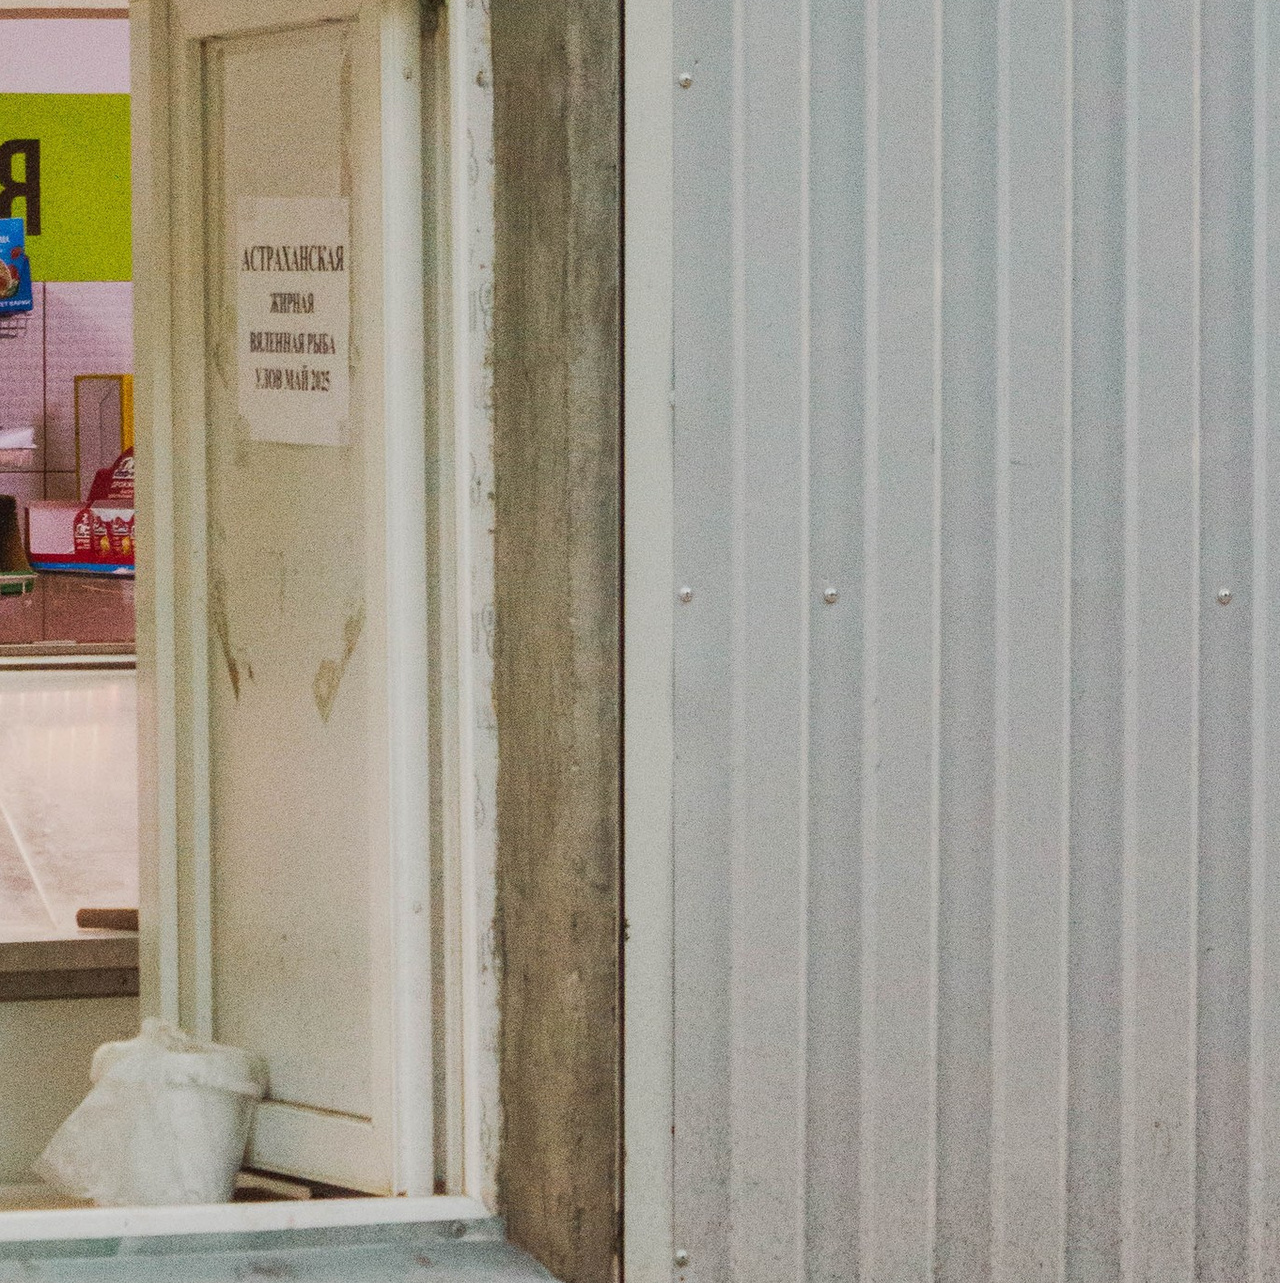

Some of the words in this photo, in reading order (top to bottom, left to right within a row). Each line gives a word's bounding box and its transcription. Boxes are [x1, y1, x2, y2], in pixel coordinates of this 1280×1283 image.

[241, 245, 344, 271] АСТРАХАНСКАЯ
[269, 292, 314, 312] ЖИРНАЯ
[249, 331, 305, 353] ВЯЛЕННАЯ
[307, 332, 336, 353] РЫБА
[254, 367, 282, 389] УЛОВ
[284, 364, 308, 390] МАЙ
